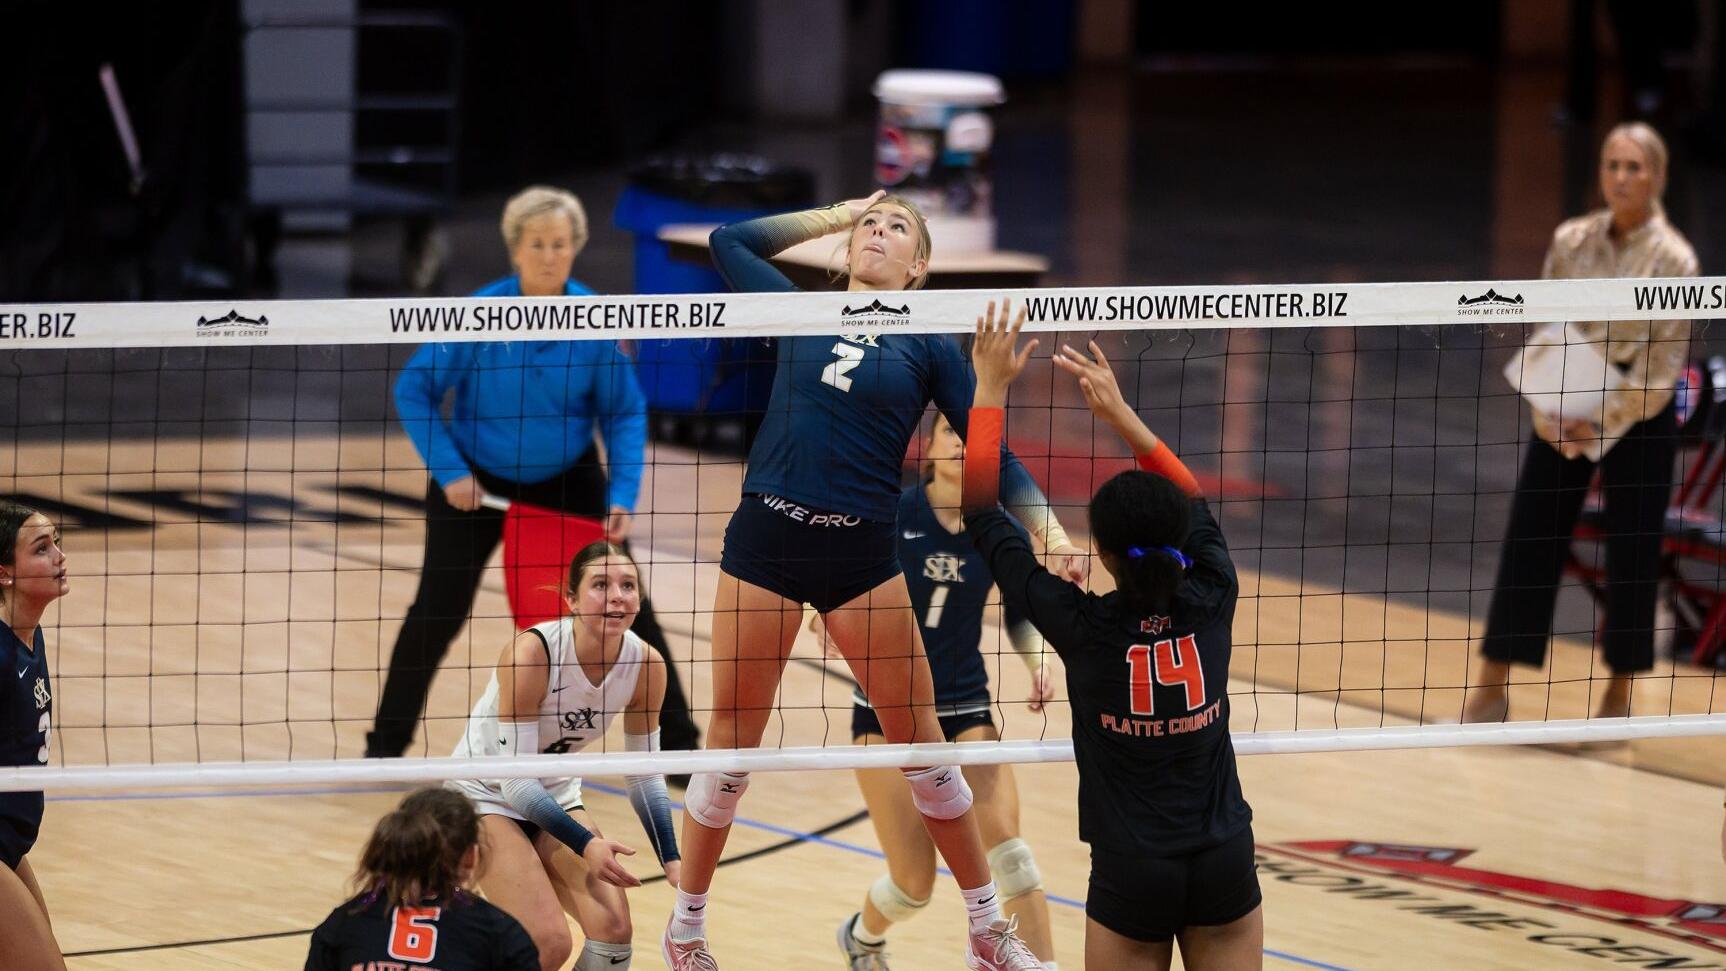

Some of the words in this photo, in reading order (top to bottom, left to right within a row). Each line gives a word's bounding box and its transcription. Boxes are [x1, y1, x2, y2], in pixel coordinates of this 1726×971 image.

[1025, 292, 1349, 322] WWW.SHOWMECENTER.BIZ
[1496, 308, 1524, 316] CENTER
[1634, 284, 1726, 311] WWW.S
[0, 313, 76, 339] ER.BIZ
[389, 302, 727, 333] WWW.SHOWMECENTER.BIZ
[841, 320, 865, 328] SHOW
[820, 342, 865, 393] 2
[759, 493, 810, 522] NIKE
[808, 514, 862, 528] PRO
[924, 586, 951, 629] 1
[1126, 633, 1206, 716] 14
[1101, 713, 1165, 737] PLATTE
[1168, 698, 1221, 735] COUNTY
[1254, 854, 1441, 901] HOW
[388, 905, 441, 963] 6
